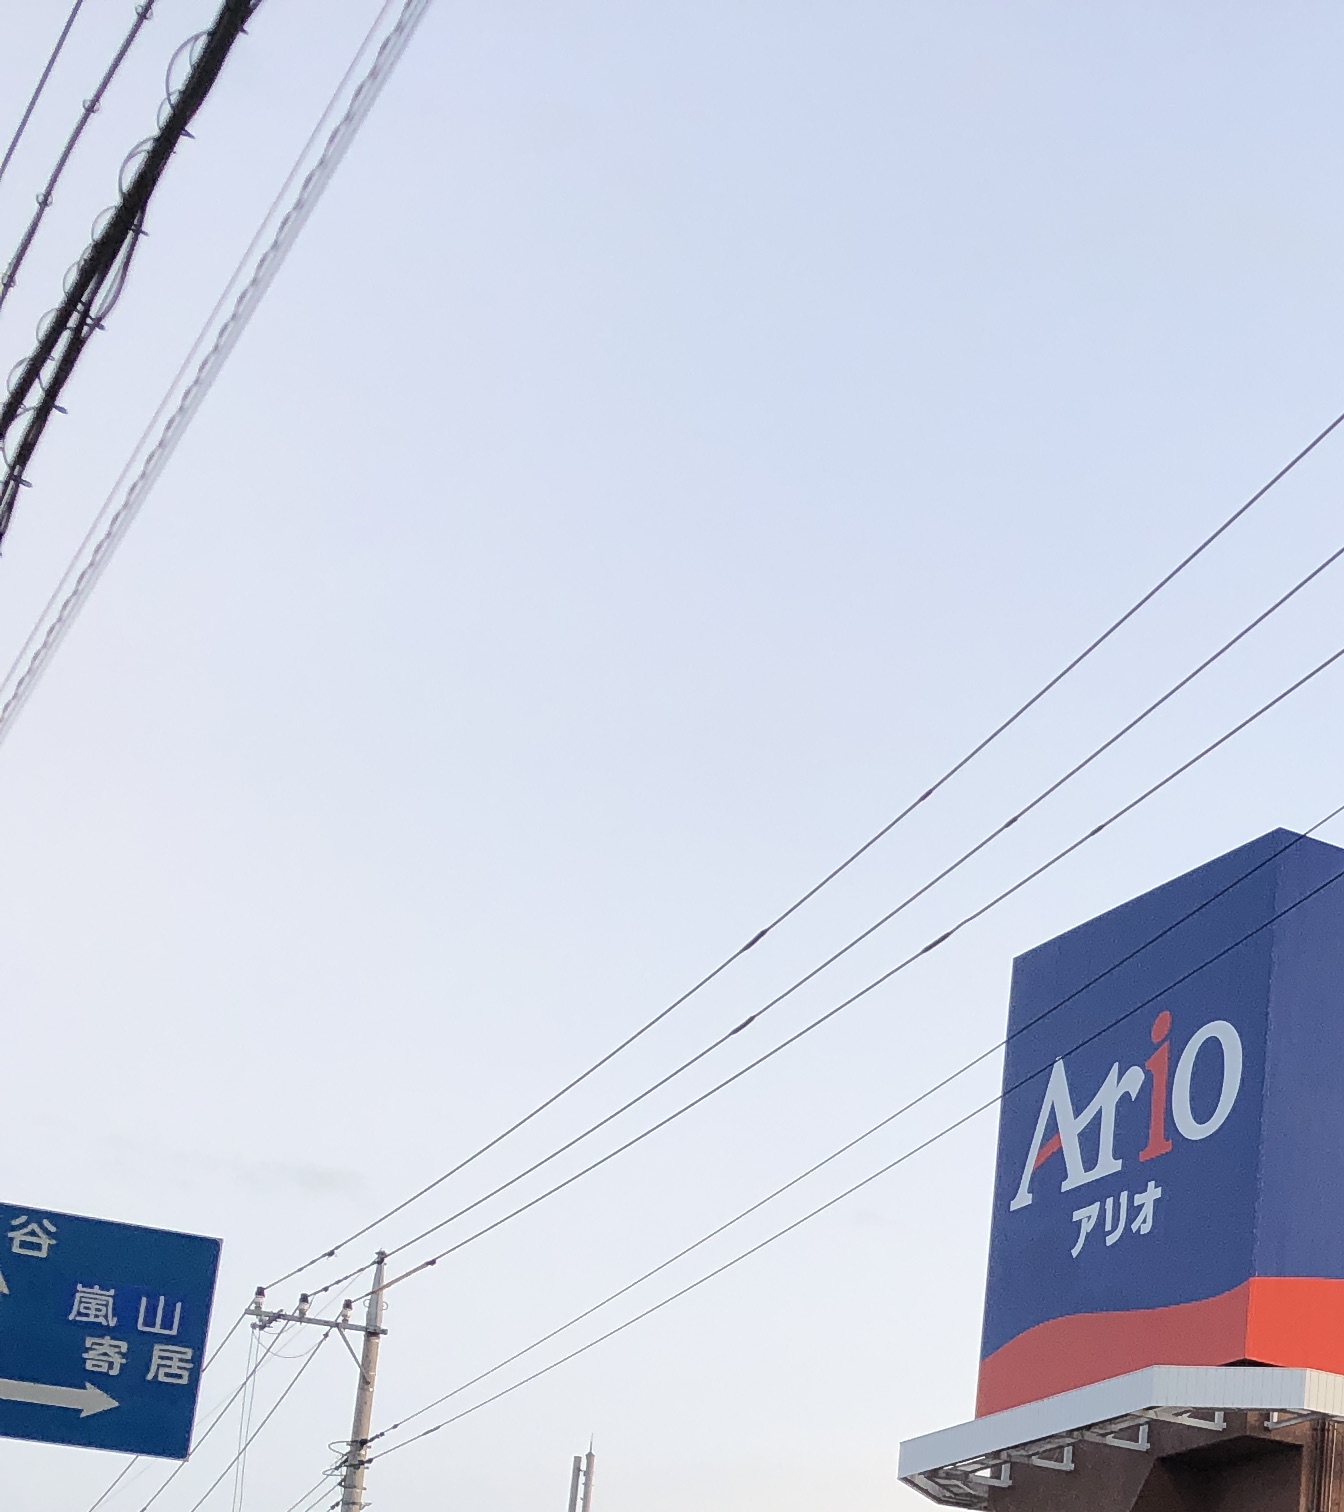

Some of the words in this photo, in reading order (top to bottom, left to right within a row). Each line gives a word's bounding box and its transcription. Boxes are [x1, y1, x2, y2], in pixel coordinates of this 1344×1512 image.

[1009, 1010, 1243, 1212] Ario
[1070, 1180, 1163, 1259] アリオ
[67, 1283, 182, 1336] 嵐山
[82, 1336, 194, 1385] 寄居
